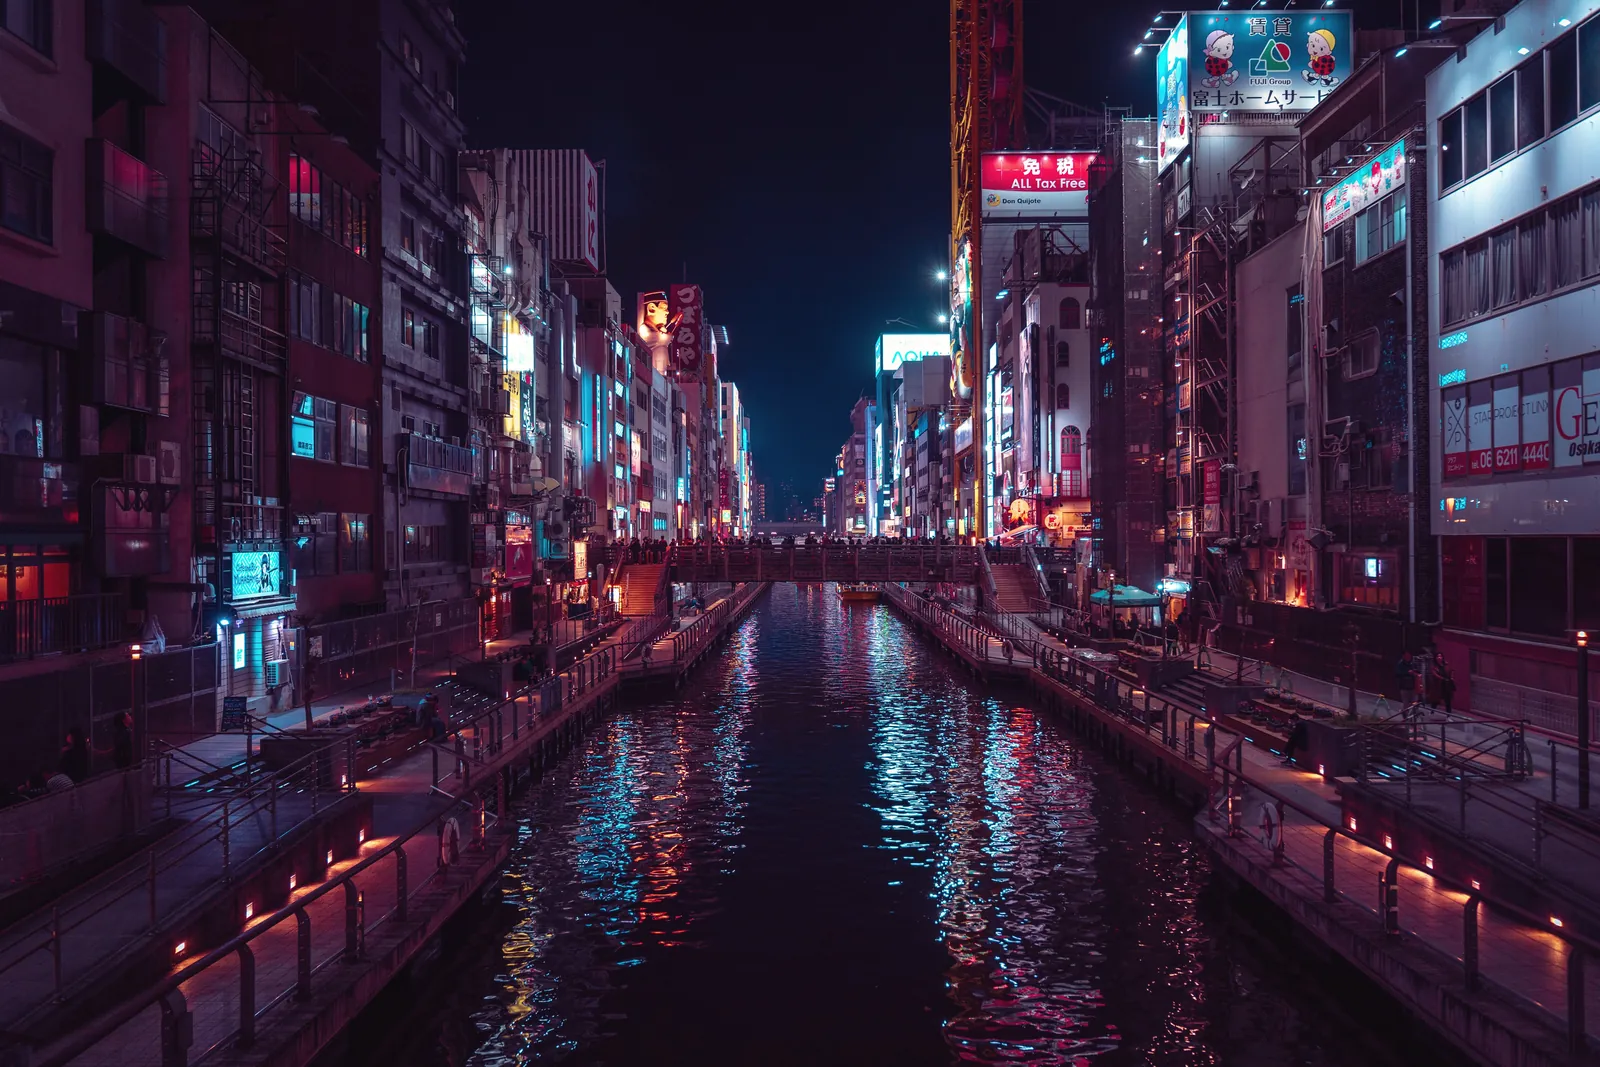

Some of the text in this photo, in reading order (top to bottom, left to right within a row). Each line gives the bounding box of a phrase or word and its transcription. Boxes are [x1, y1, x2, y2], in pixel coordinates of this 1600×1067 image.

[1249, 17, 1292, 37] 賃貸
[1269, 78, 1292, 86] Group
[1023, 157, 1074, 176] 免税
[1011, 178, 1087, 188] ALL Tax Free
[1480, 450, 1492, 468] 06
[1496, 447, 1518, 467] 6211
[1569, 440, 1600, 457] Osaka
